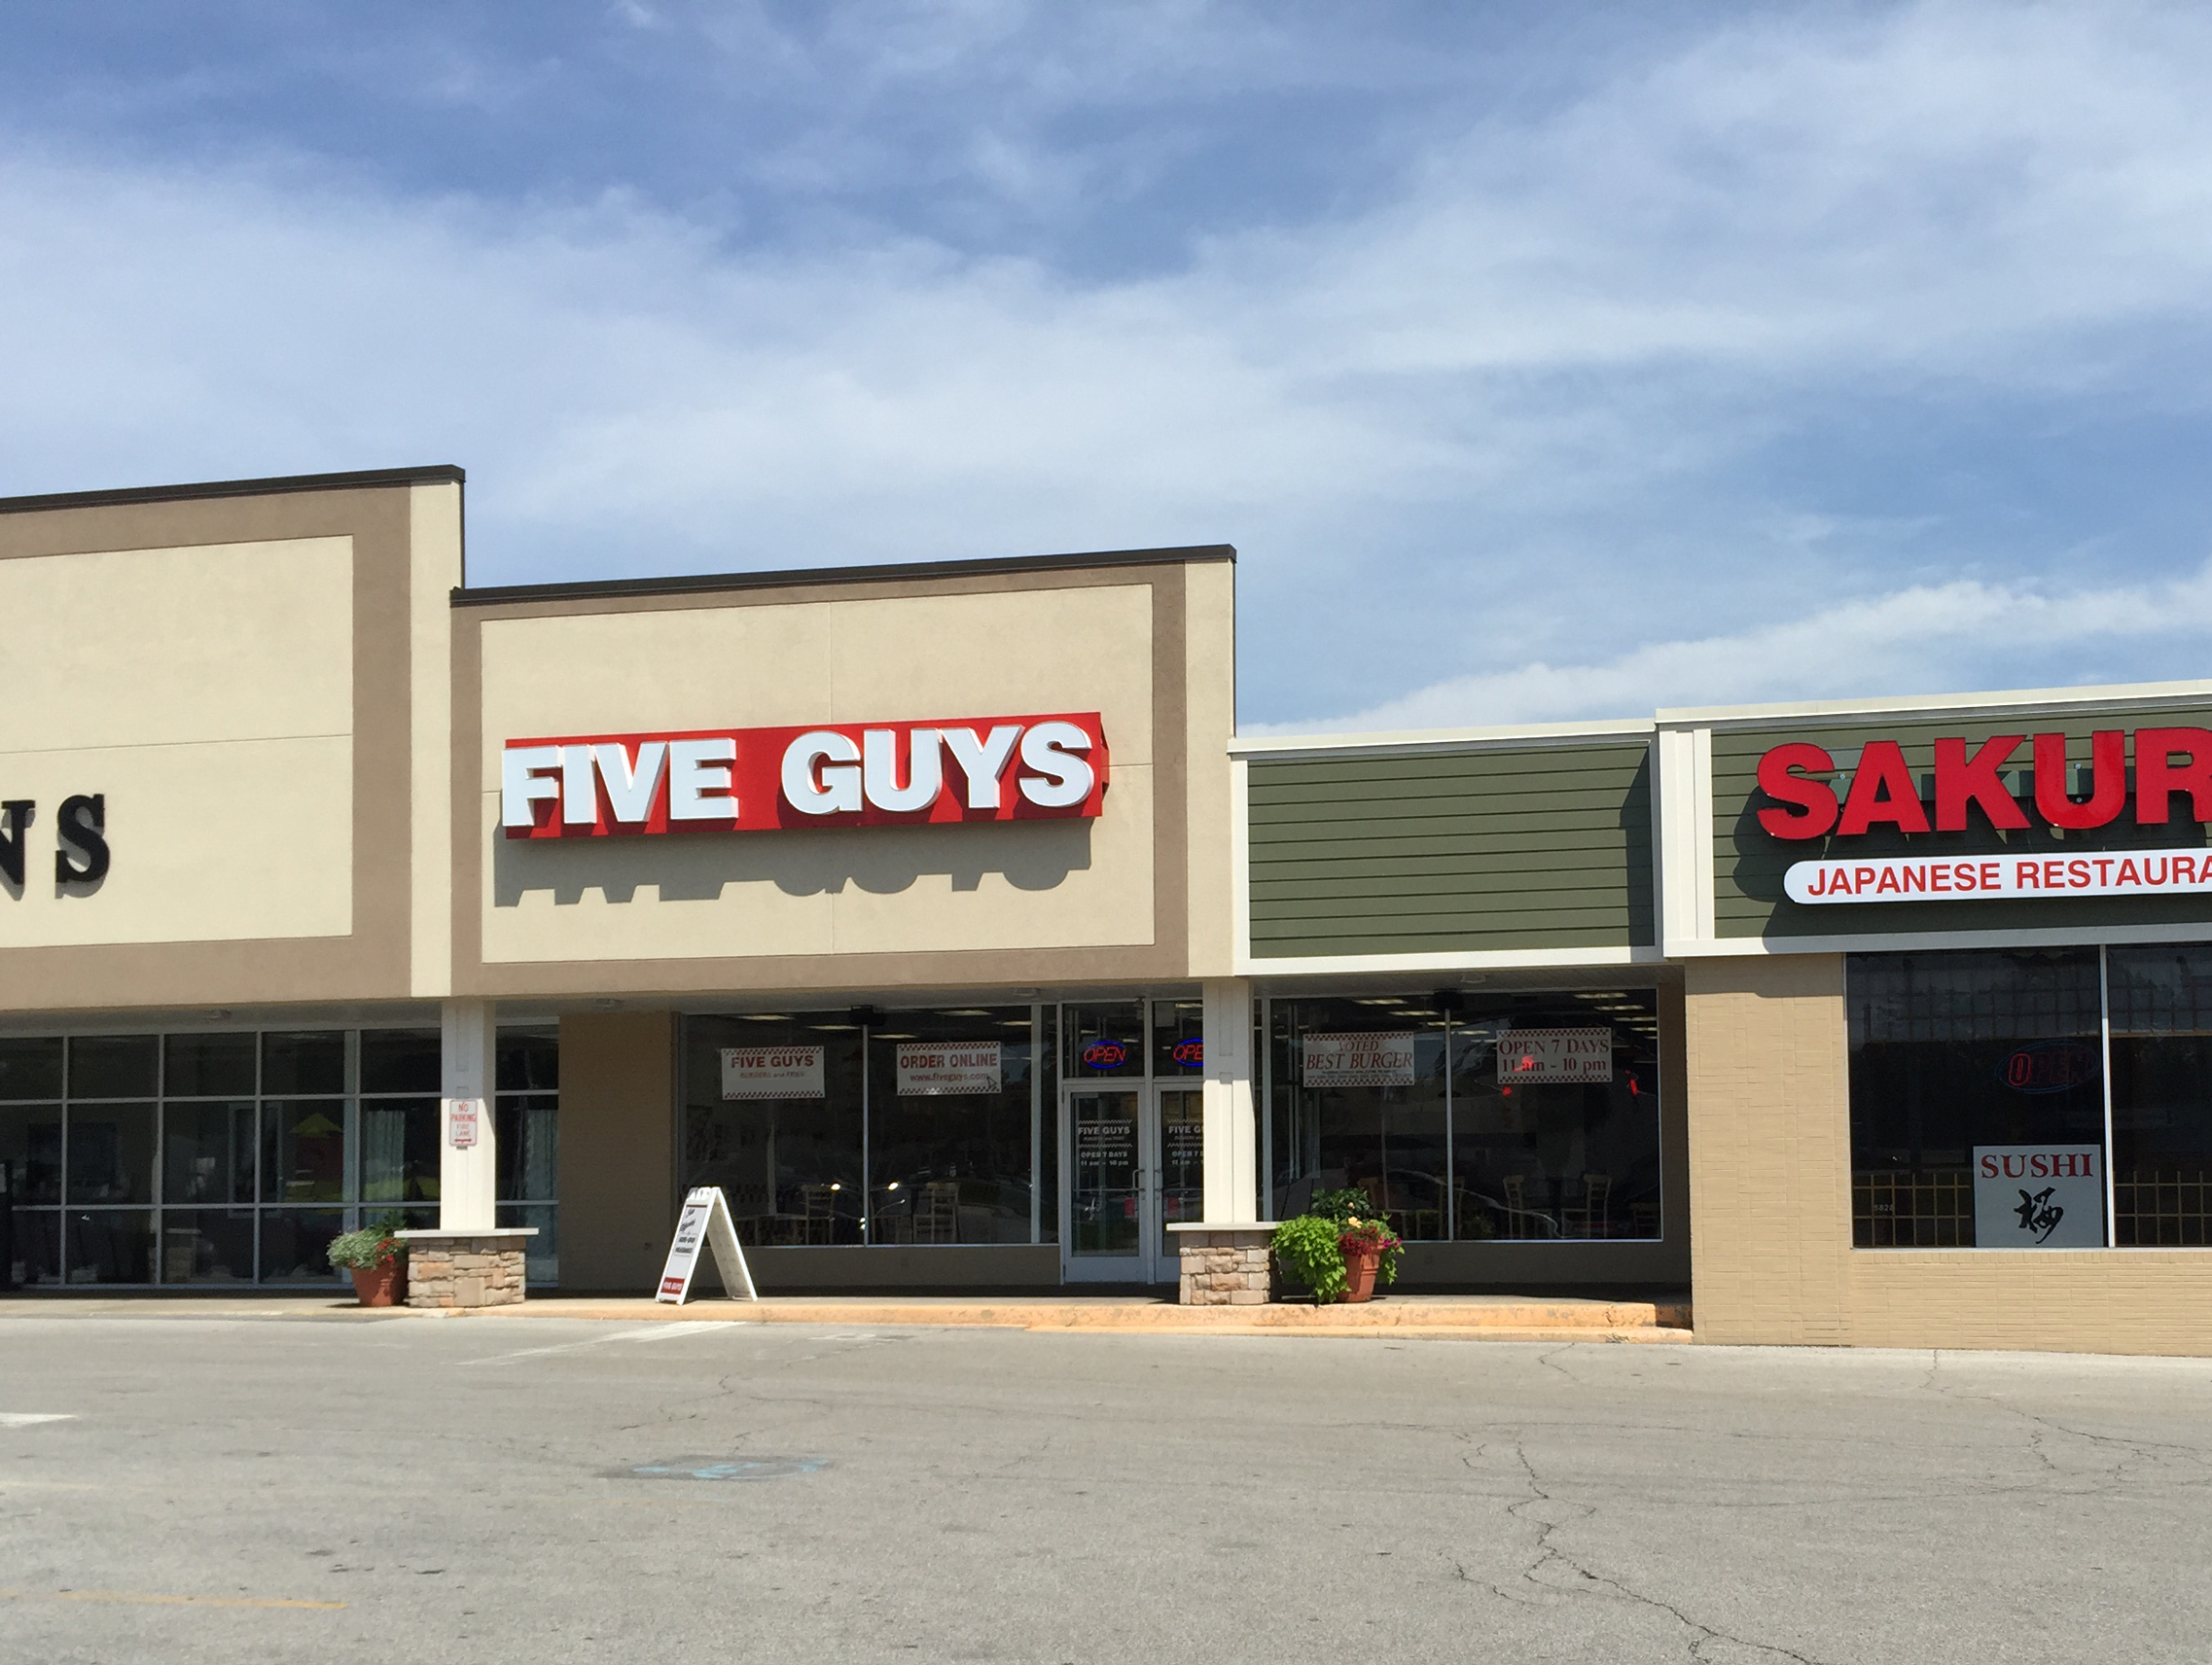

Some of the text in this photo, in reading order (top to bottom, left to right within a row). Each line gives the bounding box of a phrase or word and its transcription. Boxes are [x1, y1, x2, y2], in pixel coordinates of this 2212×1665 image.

[502, 721, 1095, 827] FIVE GUYS
[1757, 726, 2212, 840] SAKUR
[1807, 862, 2002, 897] JAPANESE
[1083, 1045, 1126, 1063] OPEN
[1338, 1040, 1379, 1051] VOTED
[1499, 1039, 1610, 1054] OPEN 7 DAYS
[731, 1054, 815, 1068] FIVE GUYS
[900, 1052, 998, 1069] ORDER ONLINE
[1305, 1051, 1413, 1070] BEST BURGER
[1563, 1057, 1577, 1071] 10
[1583, 1059, 1607, 1075] pm
[2008, 1050, 2091, 1086] OPEN
[1077, 1126, 1130, 1135] FIVE GUYS
[1168, 1124, 1203, 1134] FIVE G
[1980, 1153, 2094, 1179] SUSHI
